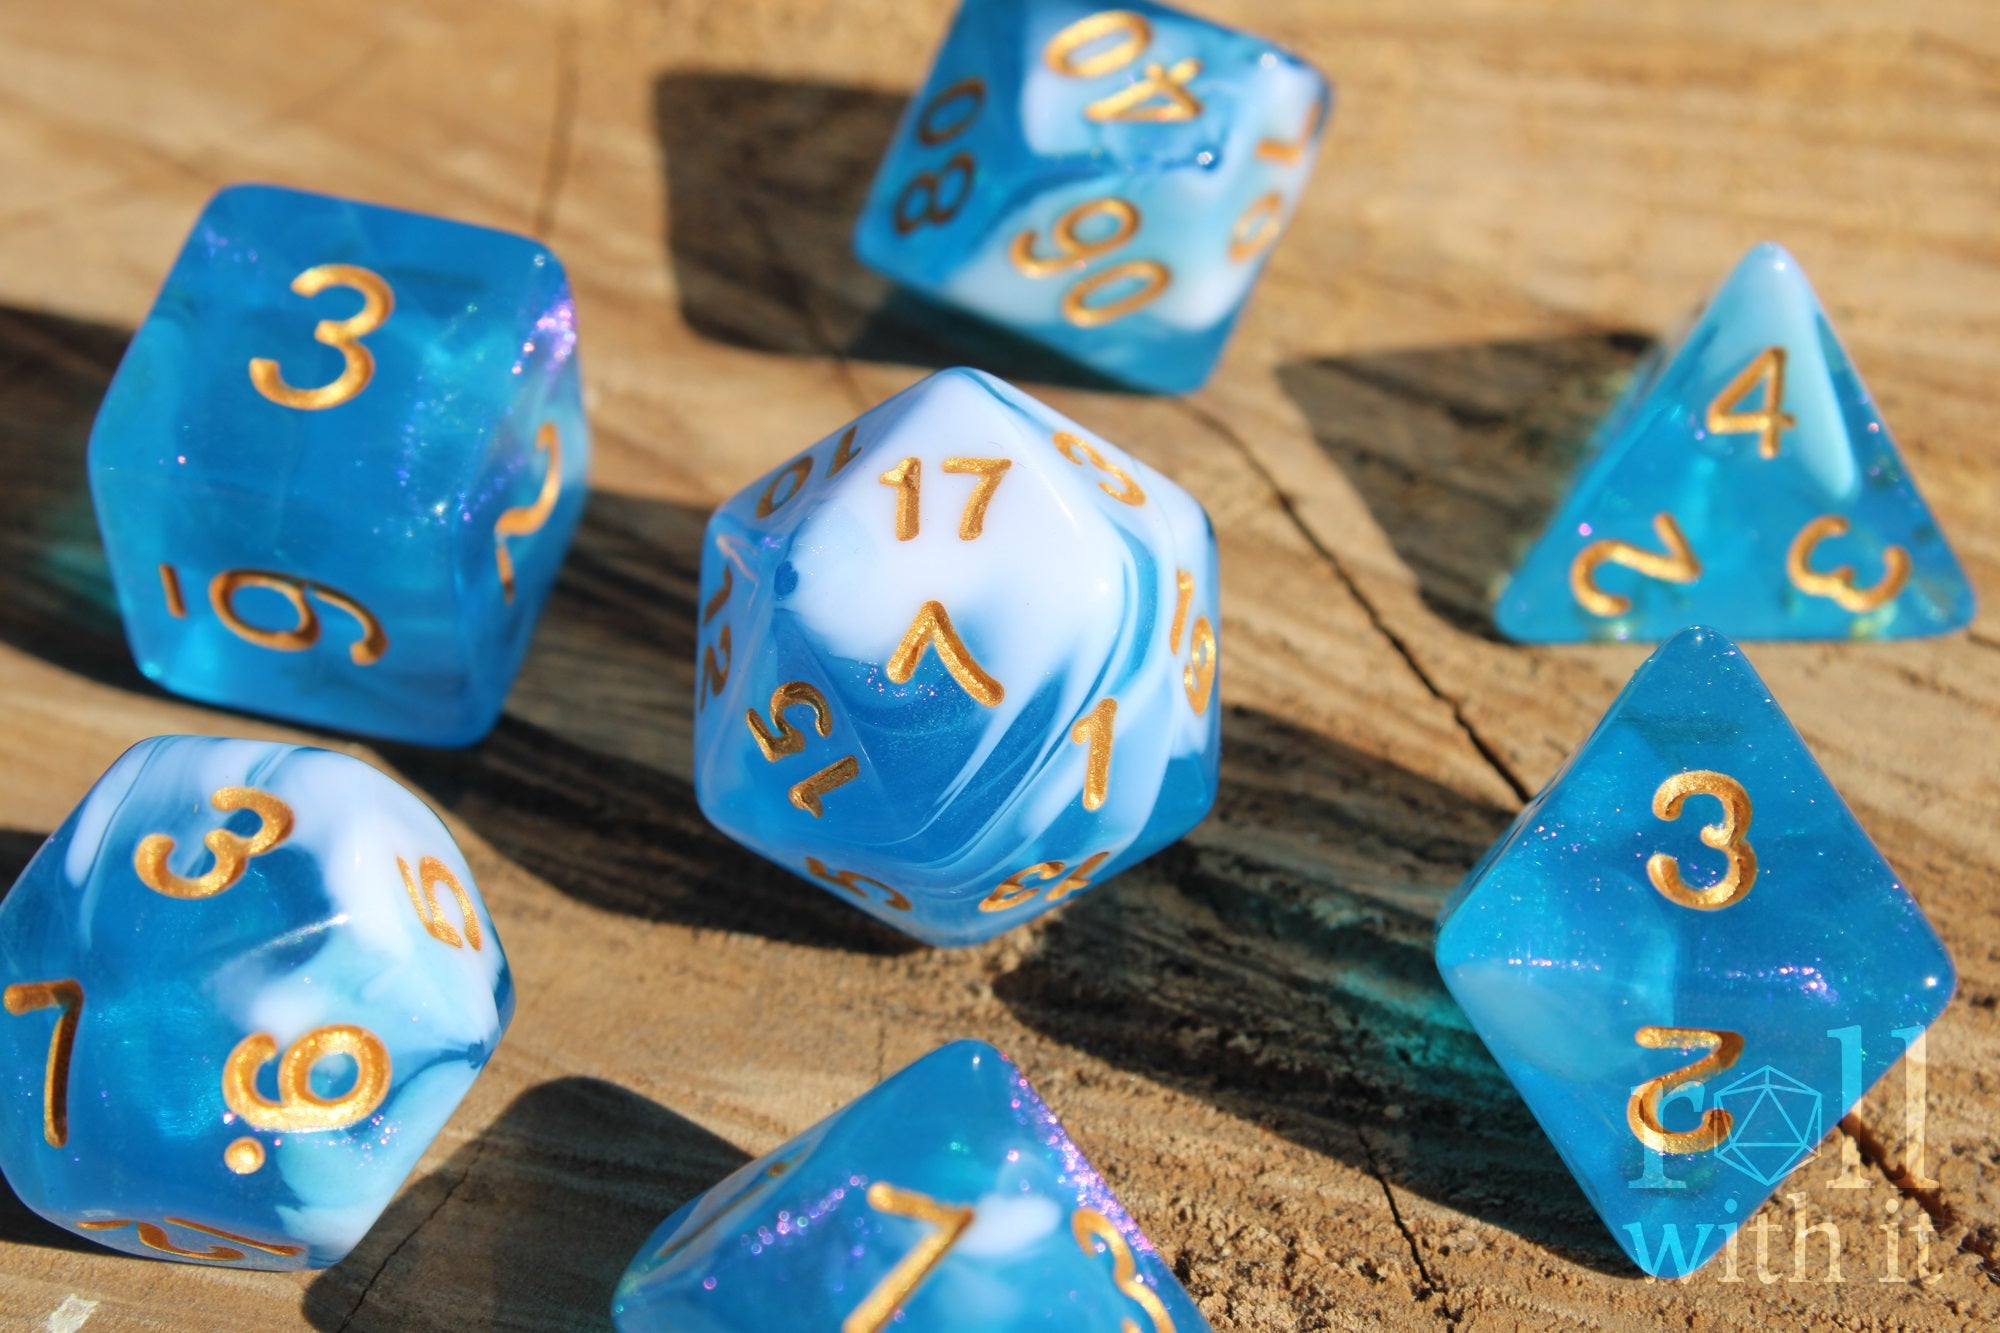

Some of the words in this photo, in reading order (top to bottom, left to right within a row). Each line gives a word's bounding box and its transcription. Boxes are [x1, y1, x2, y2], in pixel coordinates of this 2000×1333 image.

[1043, 9, 1203, 122] 40
[892, 76, 987, 236] 80
[1009, 198, 1172, 328] 90
[249, 264, 395, 411] 3
[1707, 346, 1795, 460] 4
[755, 424, 862, 519] 10
[880, 456, 1012, 541] 17
[1053, 431, 1146, 506] 3
[1570, 512, 1703, 617] 2
[1787, 516, 1912, 614] 3
[886, 600, 1004, 708] 7
[746, 681, 859, 818] 15
[1071, 698, 1118, 810] 1
[134, 785, 295, 899] 3
[1646, 770, 1758, 911] 3
[396, 855, 482, 951] 5
[3, 977, 84, 1148] 7
[1626, 1025, 1745, 1155] 2
[842, 1181, 975, 1333] 7
